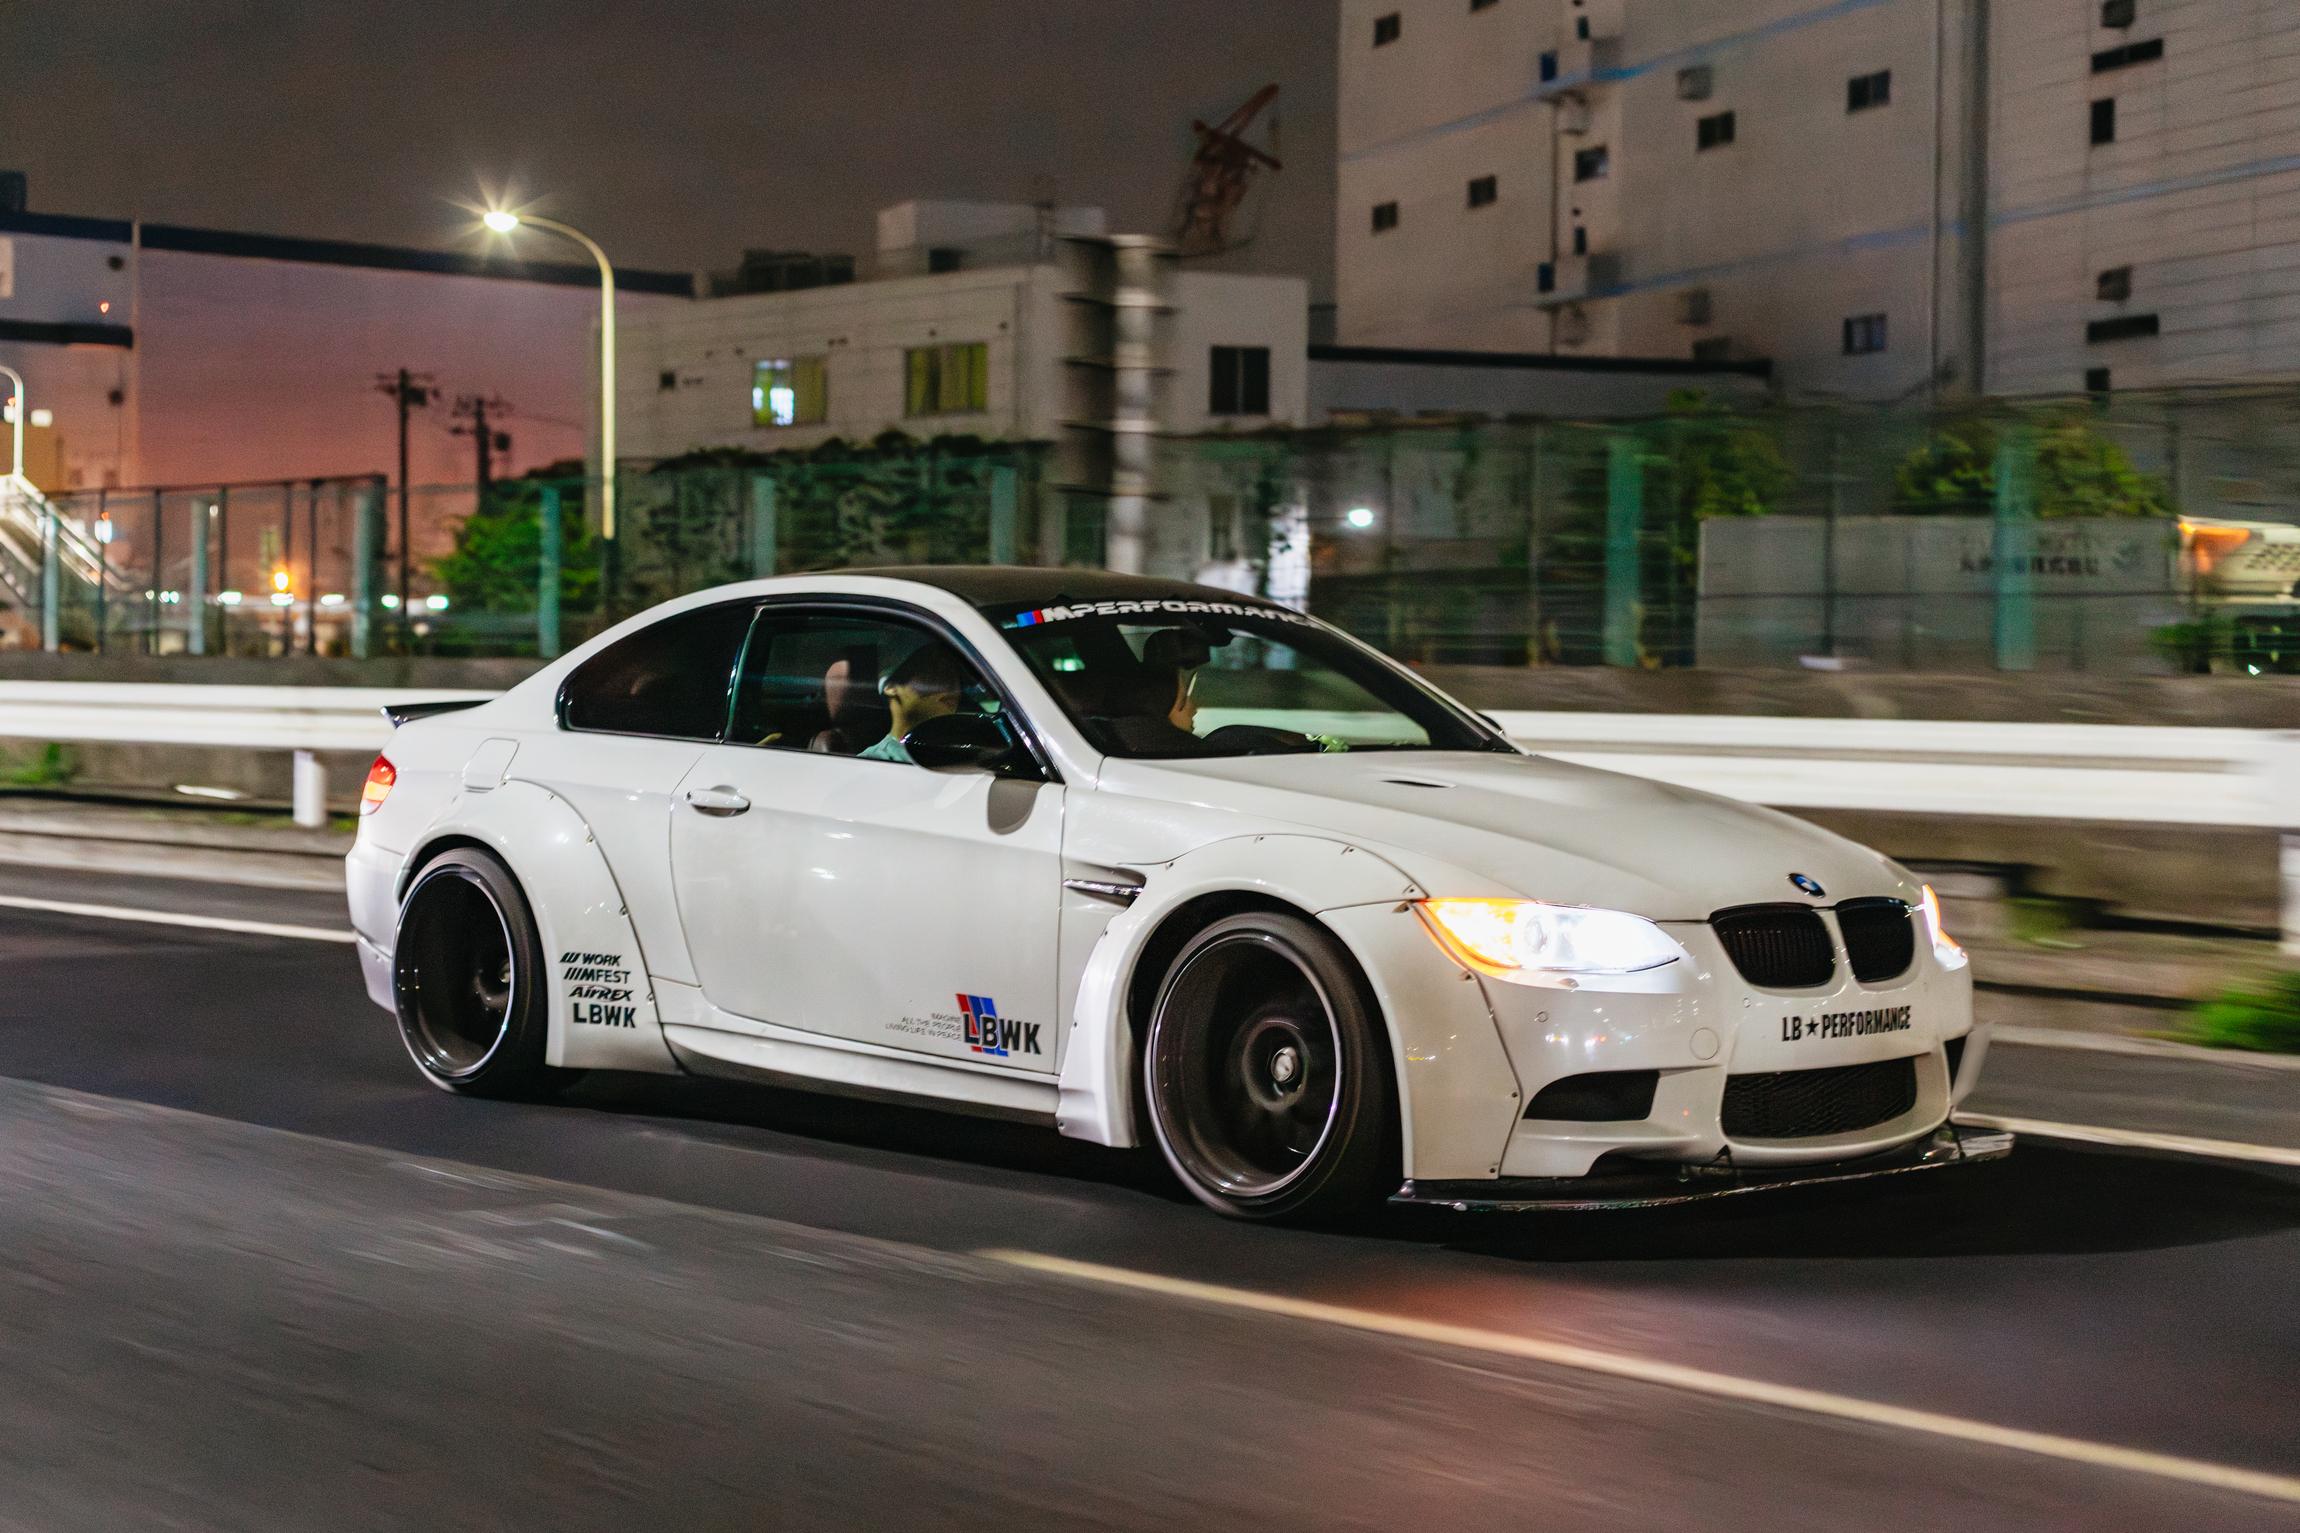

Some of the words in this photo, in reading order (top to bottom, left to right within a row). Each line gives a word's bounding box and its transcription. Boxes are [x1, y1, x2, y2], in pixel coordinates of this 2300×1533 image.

[582, 952, 622, 967] WORK
[573, 1002, 636, 1029] LBWK
[1782, 1016, 1803, 1042] LB
[1821, 1005, 1912, 1040] PERFORMANCE
[963, 1012, 1041, 1055] LBWK
